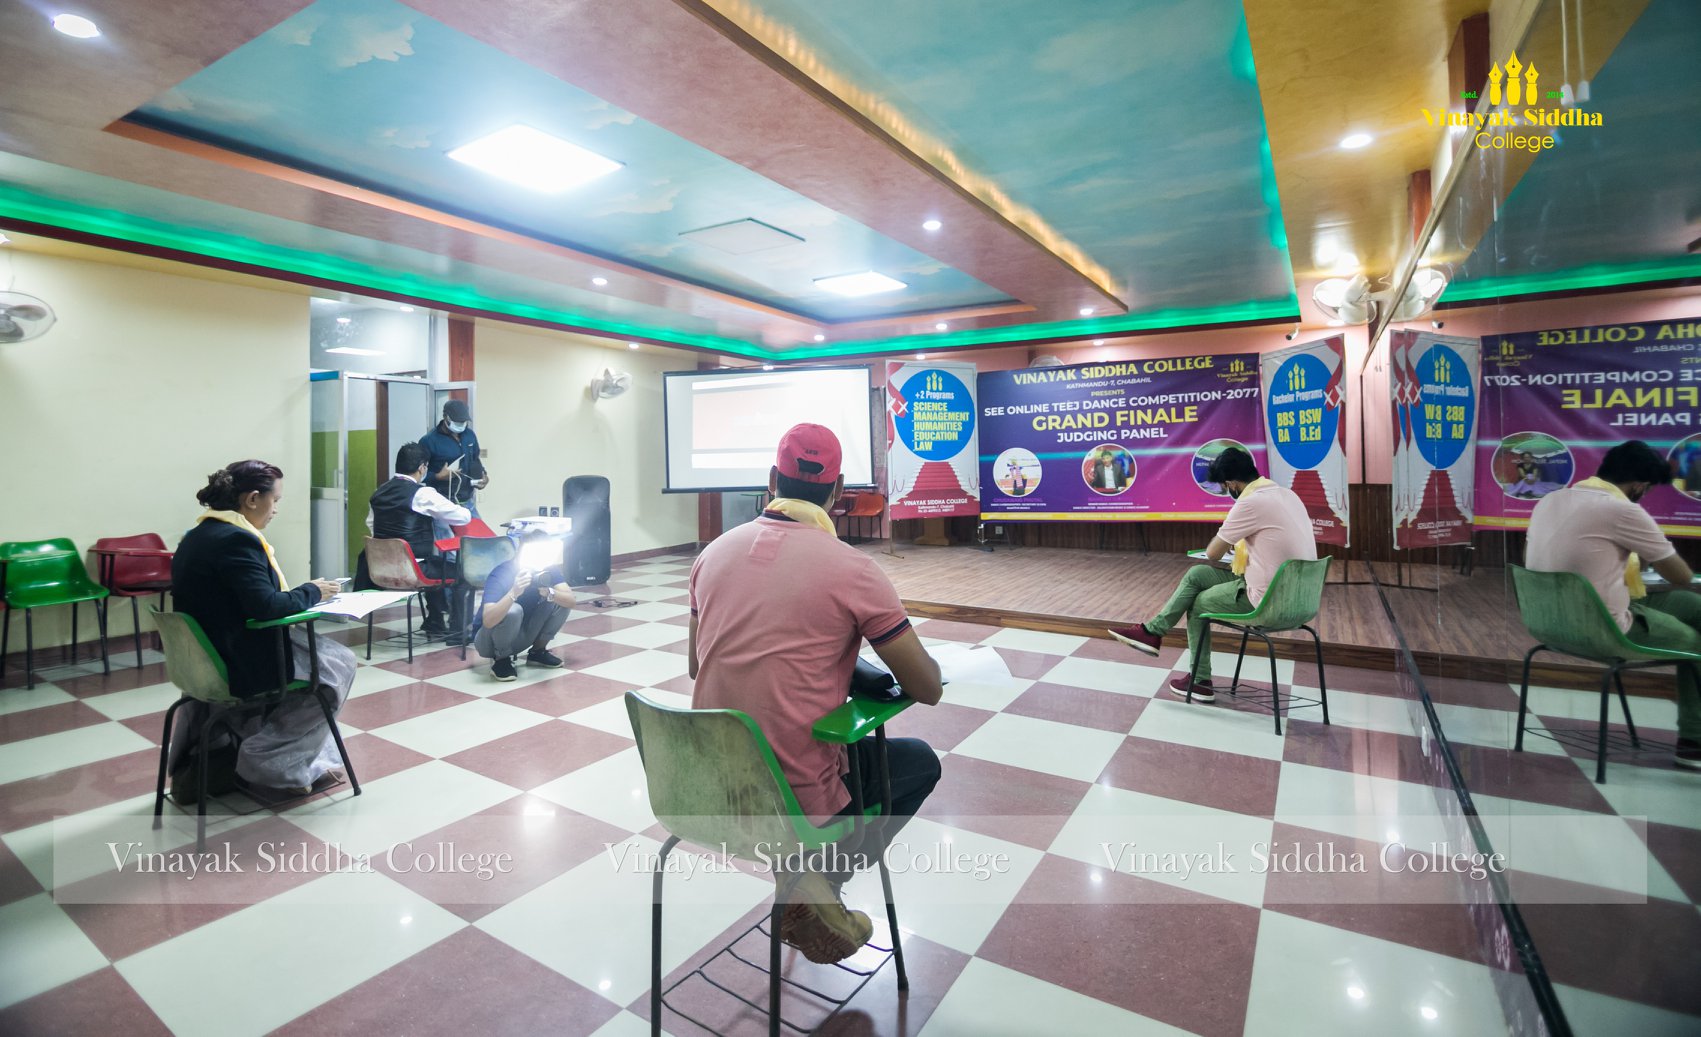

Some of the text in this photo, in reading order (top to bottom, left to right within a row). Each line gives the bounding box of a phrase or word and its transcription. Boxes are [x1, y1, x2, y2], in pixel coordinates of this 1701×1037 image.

[1013, 356, 1214, 385] VINAYAK SIDDHA COLLEGE
[926, 390, 954, 400] Programs
[1091, 389, 1125, 397] PRESENTS
[1295, 388, 1323, 402] Programs
[913, 402, 948, 411] SCIENCE
[984, 387, 1259, 416] SEE ONLINE TEEJ DANCE COMPETITION-2077
[913, 412, 969, 421] MANAGEMENT
[1032, 406, 1198, 431] GRAND FINALE
[1276, 407, 1322, 427] BBS BSW
[914, 421, 962, 431] HUMANITIES
[914, 431, 958, 441] EDUCATION
[1057, 427, 1168, 443] JUDGING PANEL
[1278, 425, 1321, 443] BA B.Ed
[914, 441, 932, 451] LAW
